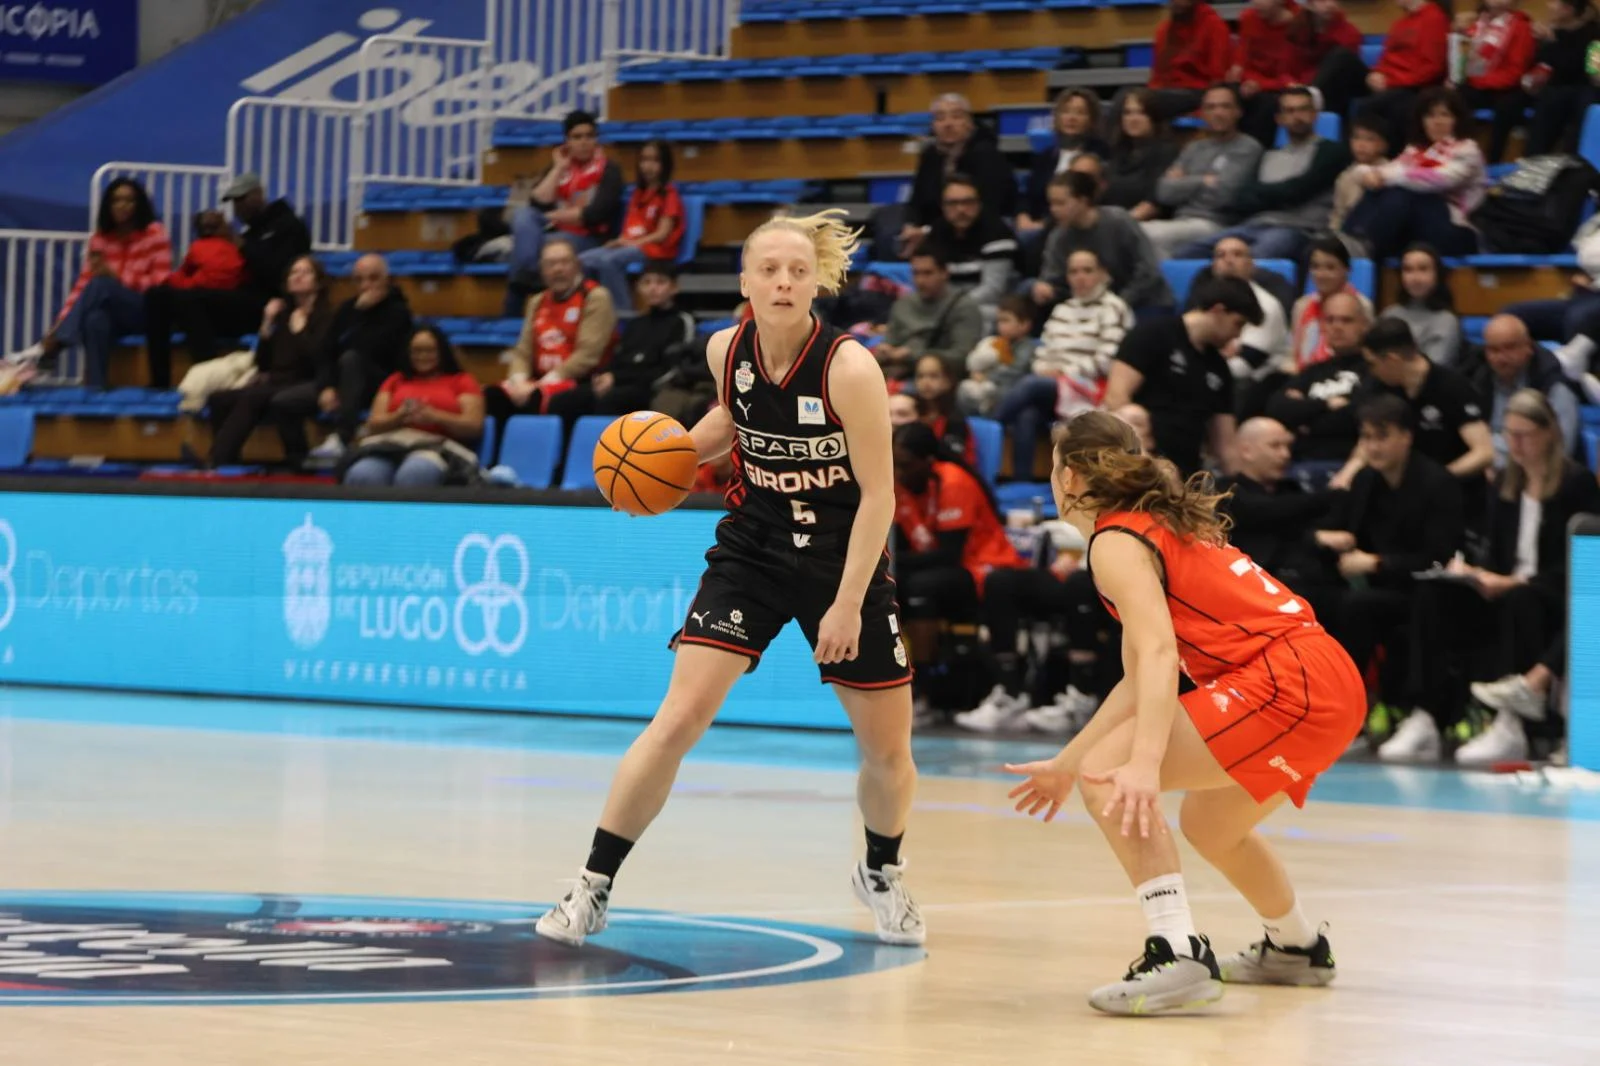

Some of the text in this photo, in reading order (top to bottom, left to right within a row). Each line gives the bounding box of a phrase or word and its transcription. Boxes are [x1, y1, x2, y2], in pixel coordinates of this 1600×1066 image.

[738, 431, 809, 456] SPAR
[743, 460, 851, 493] GIRONA
[790, 499, 817, 525] 5
[25, 550, 199, 620] Deportes
[336, 561, 448, 589] DEPUTACIÓN
[360, 595, 448, 641] LUGO
[538, 567, 696, 642] Deport
[283, 660, 528, 692] VICEPRESIDENCIA
